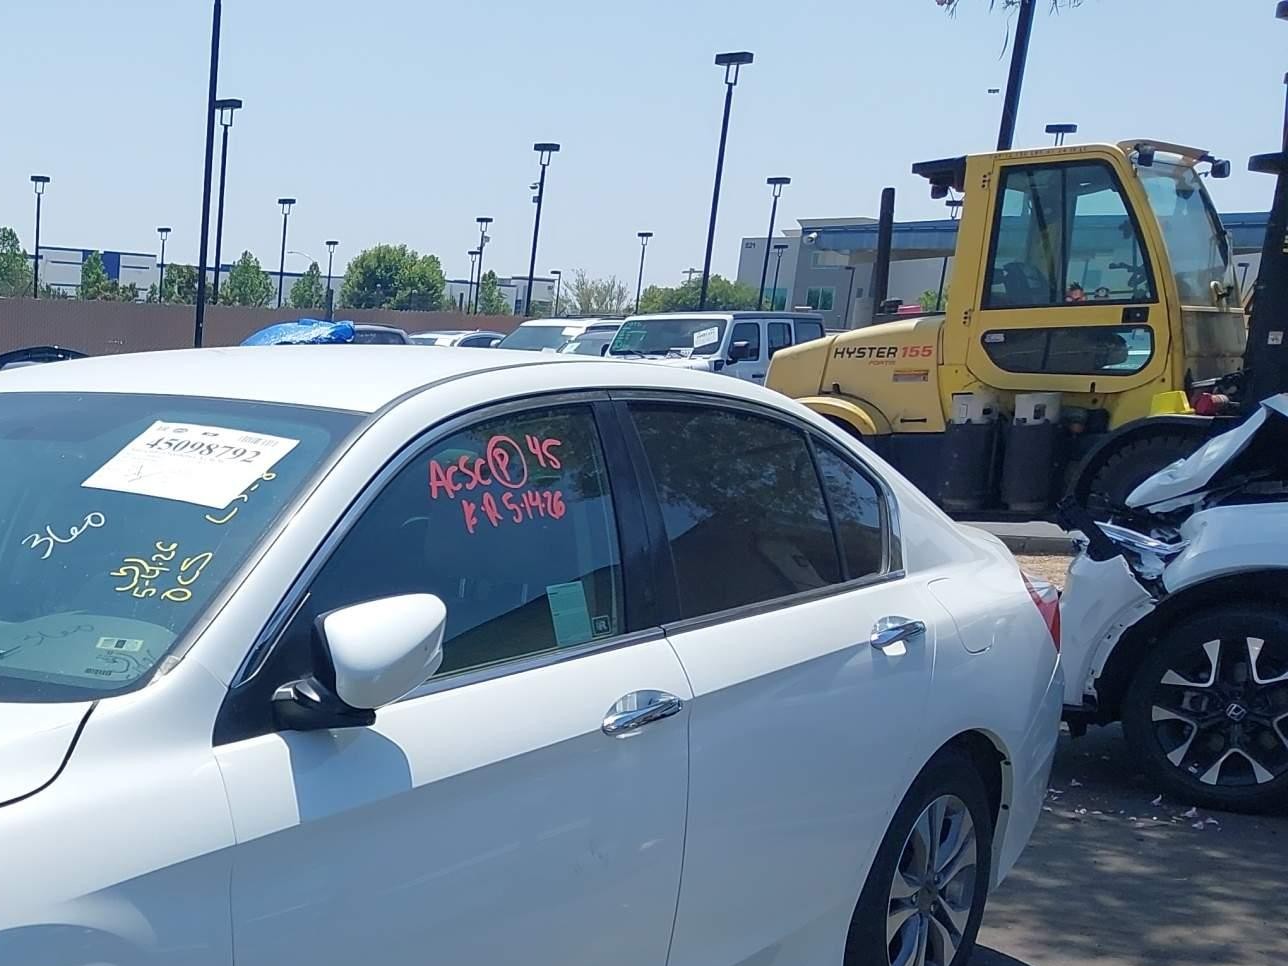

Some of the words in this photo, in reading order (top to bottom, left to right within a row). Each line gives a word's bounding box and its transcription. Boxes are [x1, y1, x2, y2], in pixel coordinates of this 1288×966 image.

[833, 346, 898, 359] HYSTER
[901, 346, 932, 358] 155
[146, 437, 262, 464] 45098792
